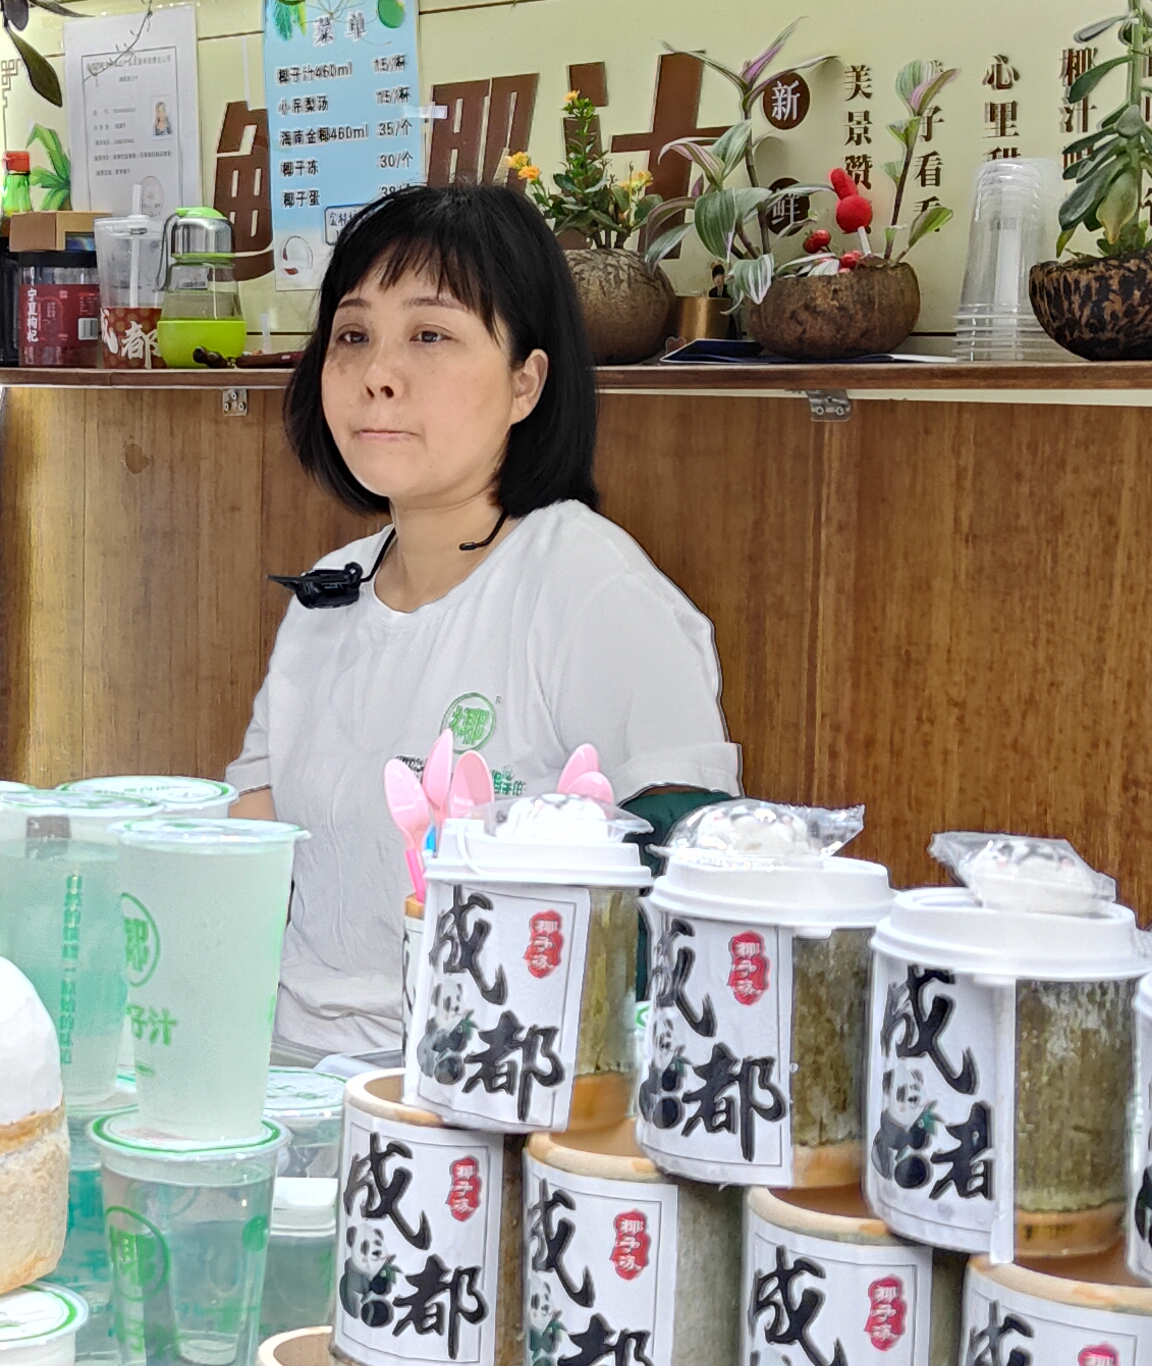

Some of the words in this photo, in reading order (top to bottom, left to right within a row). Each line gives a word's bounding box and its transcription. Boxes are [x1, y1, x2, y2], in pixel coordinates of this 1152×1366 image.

[315, 12, 366, 46] 菜单
[278, 95, 329, 116] 小吊梨汤
[377, 120, 412, 137] 35/个
[281, 160, 319, 177] 椰子冻
[379, 153, 414, 169] 30/个
[283, 190, 321, 208] 椰子蛋
[26, 287, 39, 344] 宁夏枸杞
[428, 884, 565, 1121] 成都
[344, 1133, 487, 1359] 成都
